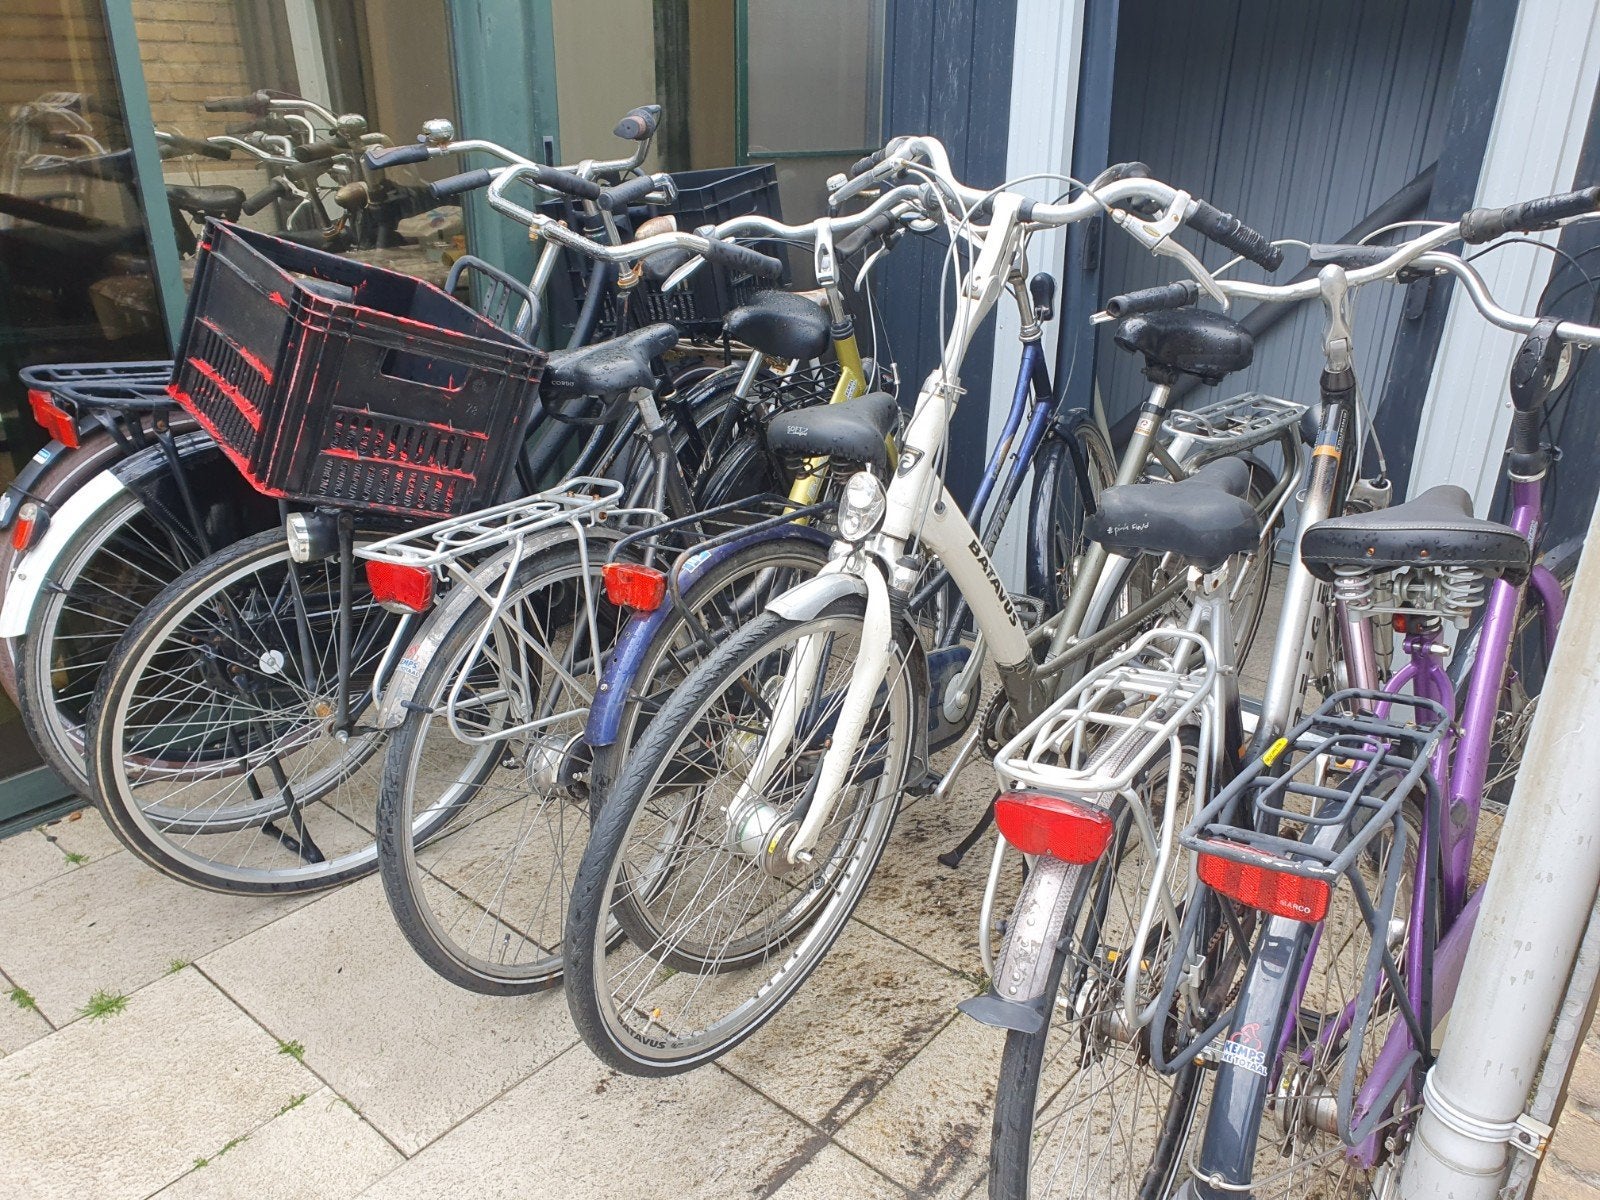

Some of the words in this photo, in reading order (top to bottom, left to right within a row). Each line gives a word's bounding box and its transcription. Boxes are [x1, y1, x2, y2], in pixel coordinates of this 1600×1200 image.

[968, 539, 1019, 627] BATAVUS
[617, 1014, 667, 1050] BATAVUS
[1225, 1041, 1265, 1064] KEMPS
[1233, 1056, 1267, 1076] TOTAAL
